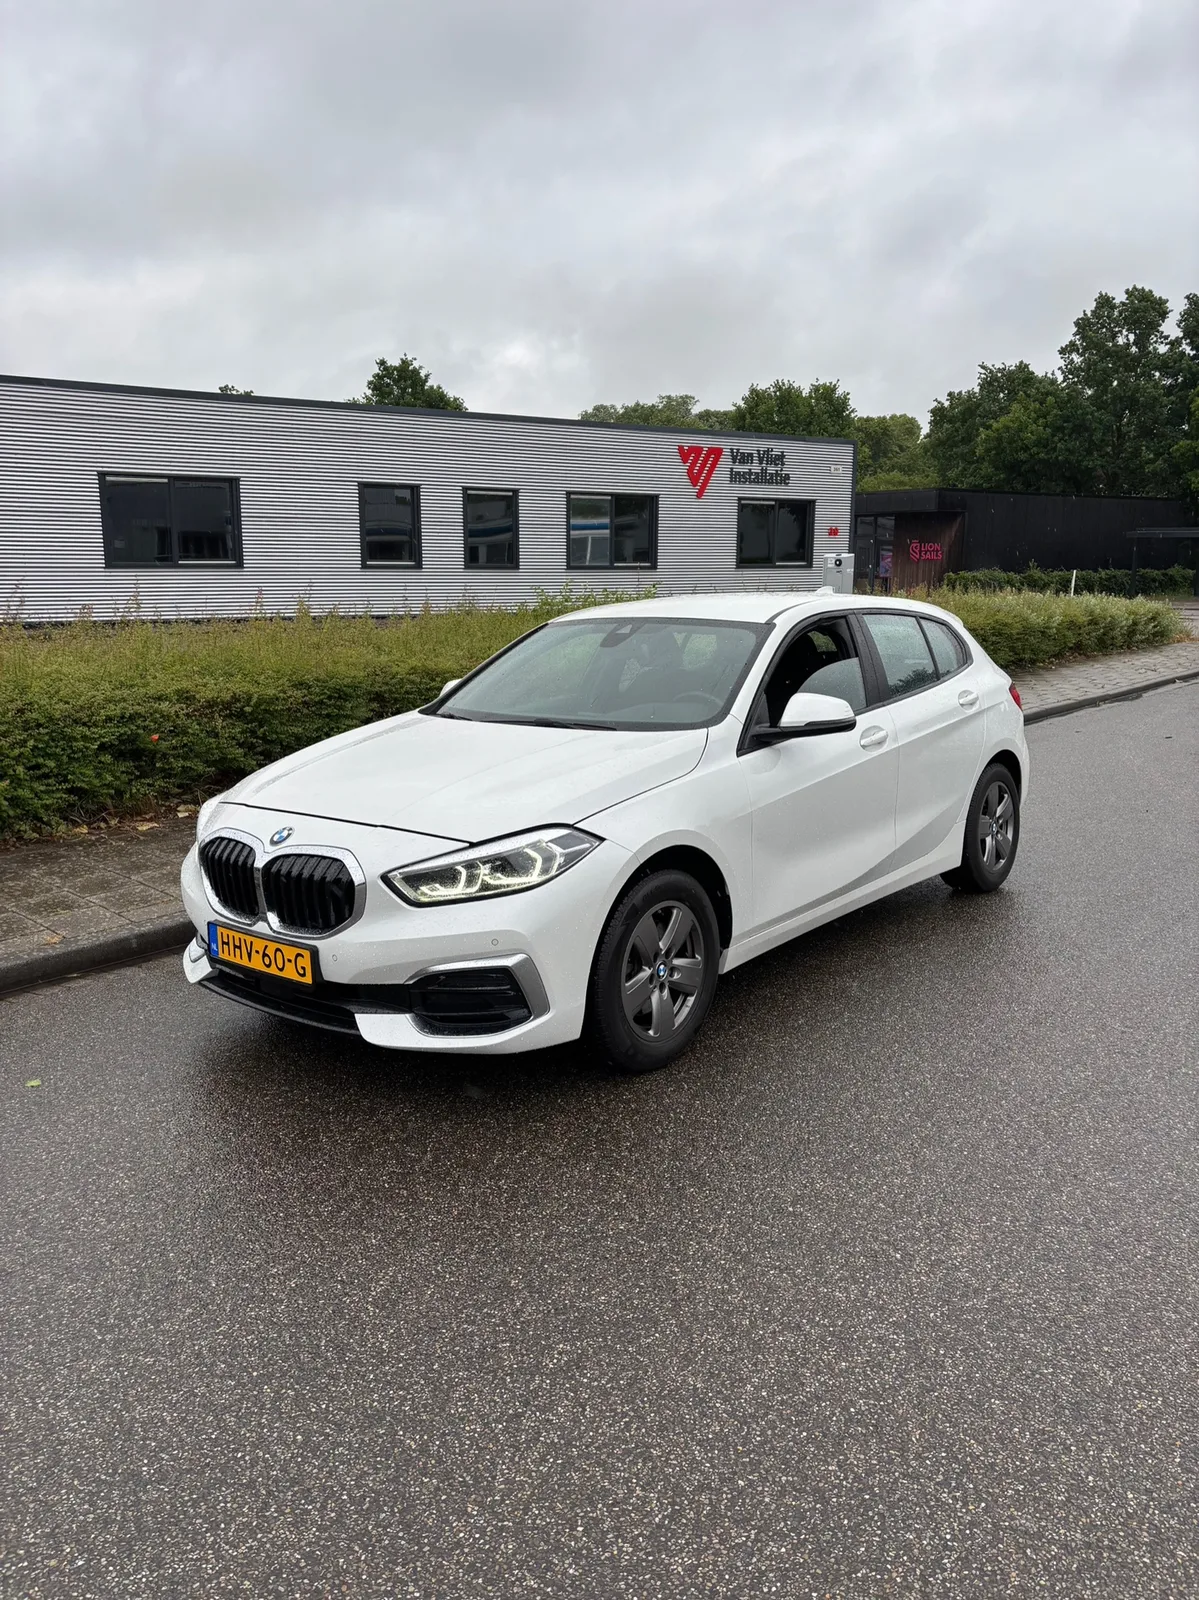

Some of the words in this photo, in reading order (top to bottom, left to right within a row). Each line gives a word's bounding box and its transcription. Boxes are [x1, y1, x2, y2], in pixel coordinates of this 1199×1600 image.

[730, 448, 753, 465] Van
[756, 447, 786, 467] Vliet
[729, 467, 791, 486] Installatie
[921, 543, 941, 551] LION
[921, 551, 942, 560] SAILS
[211, 942, 218, 952] NL
[220, 931, 307, 978] HHV-60-G
